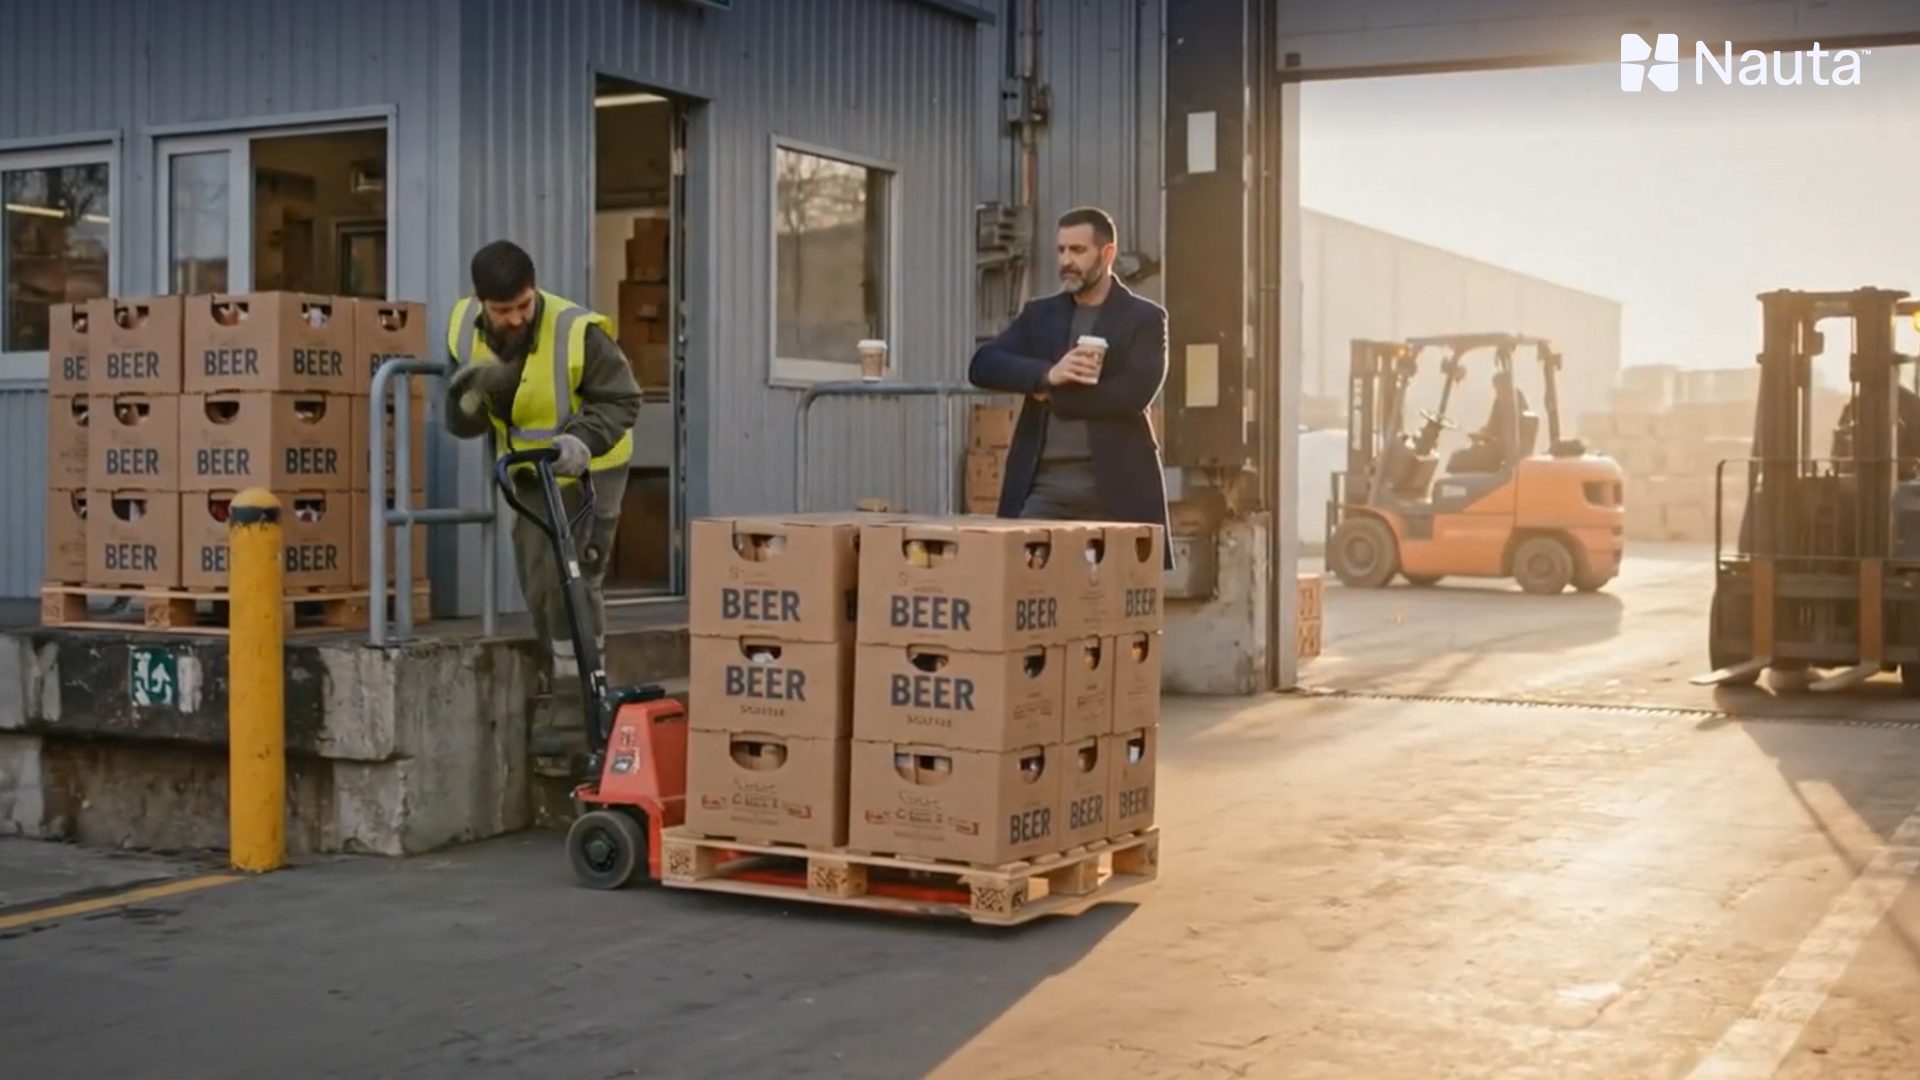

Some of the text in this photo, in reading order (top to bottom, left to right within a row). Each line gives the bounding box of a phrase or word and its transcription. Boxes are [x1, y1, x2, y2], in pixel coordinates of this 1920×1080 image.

[107, 352, 160, 379] BEER
[204, 348, 259, 376] BEER
[293, 349, 343, 376] BEER
[106, 449, 159, 475] BEER
[197, 448, 250, 475] BEER
[286, 448, 337, 475] BEER
[105, 543, 158, 571] BEER
[286, 545, 338, 572] BEER
[721, 588, 801, 622] BEER
[890, 595, 971, 631] BEER
[1016, 598, 1058, 631] BEER
[1125, 588, 1156, 618] BEER
[725, 665, 806, 701] BEER
[890, 674, 975, 711] BEER
[1070, 795, 1103, 830] BEER
[1119, 787, 1150, 819] BEER
[1010, 808, 1051, 845] BEER
